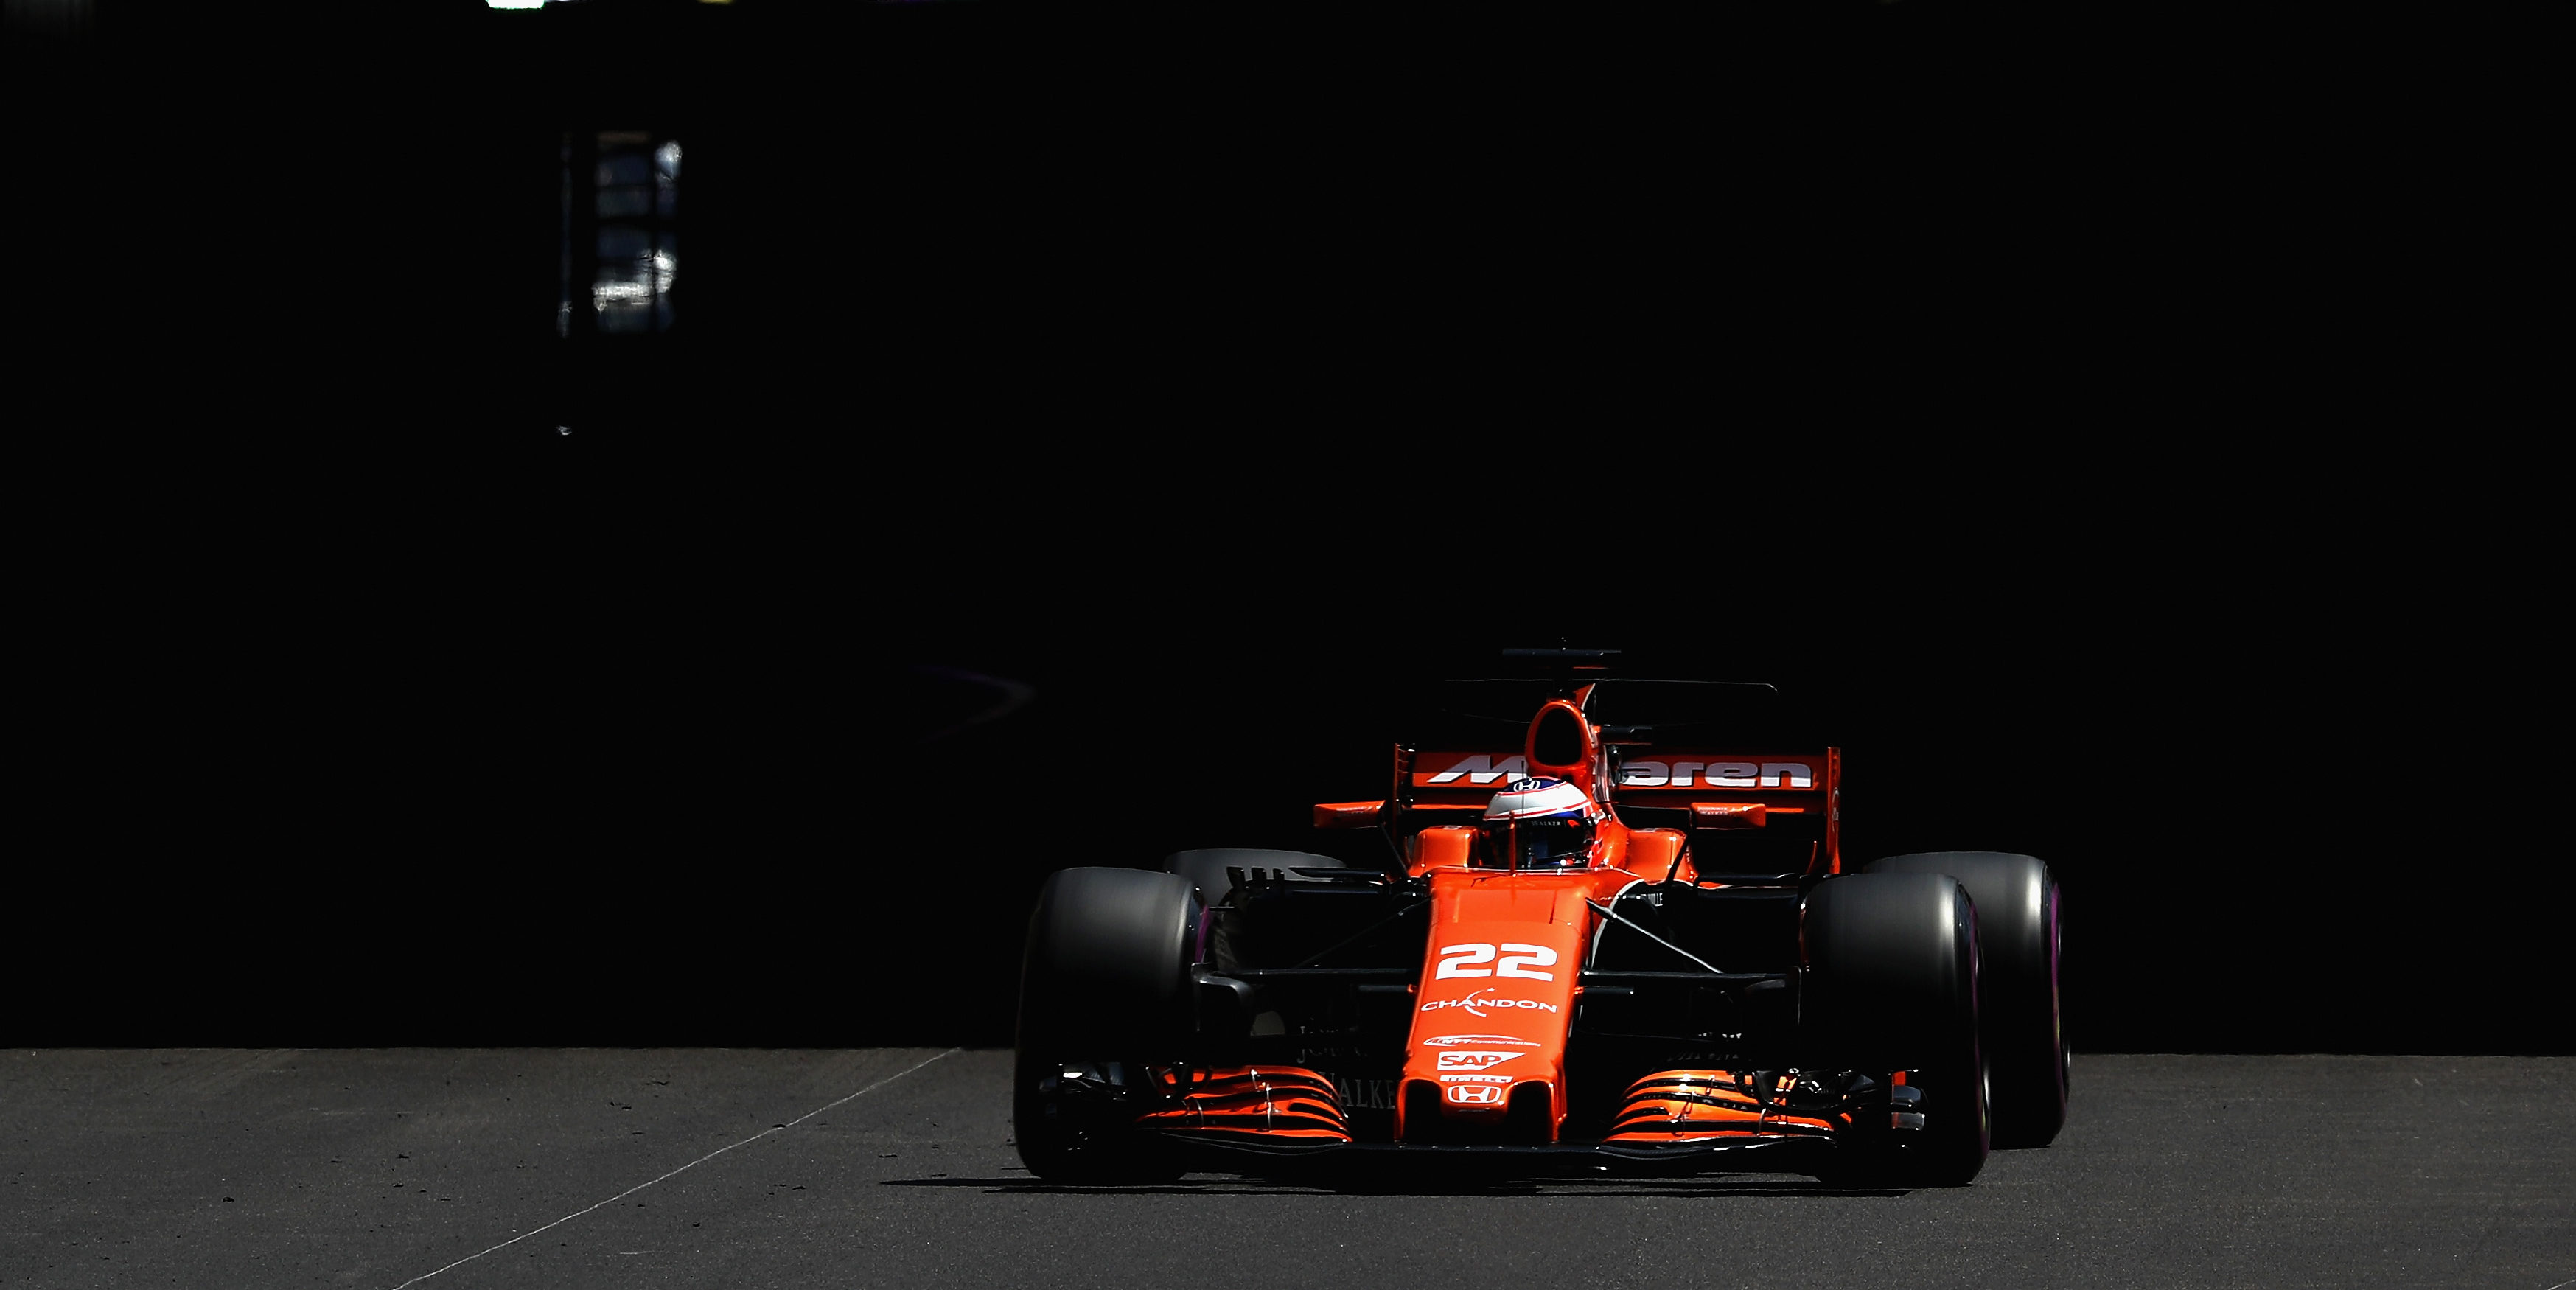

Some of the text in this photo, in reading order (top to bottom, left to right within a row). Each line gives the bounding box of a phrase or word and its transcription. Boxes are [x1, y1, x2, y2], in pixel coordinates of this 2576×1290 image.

[1426, 754, 1812, 788] Maren
[1435, 943, 1558, 982] 22
[1420, 997, 1557, 1014] CHANDON
[1440, 1054, 1502, 1067] SAP
[1318, 1071, 1400, 1109] ALKE
